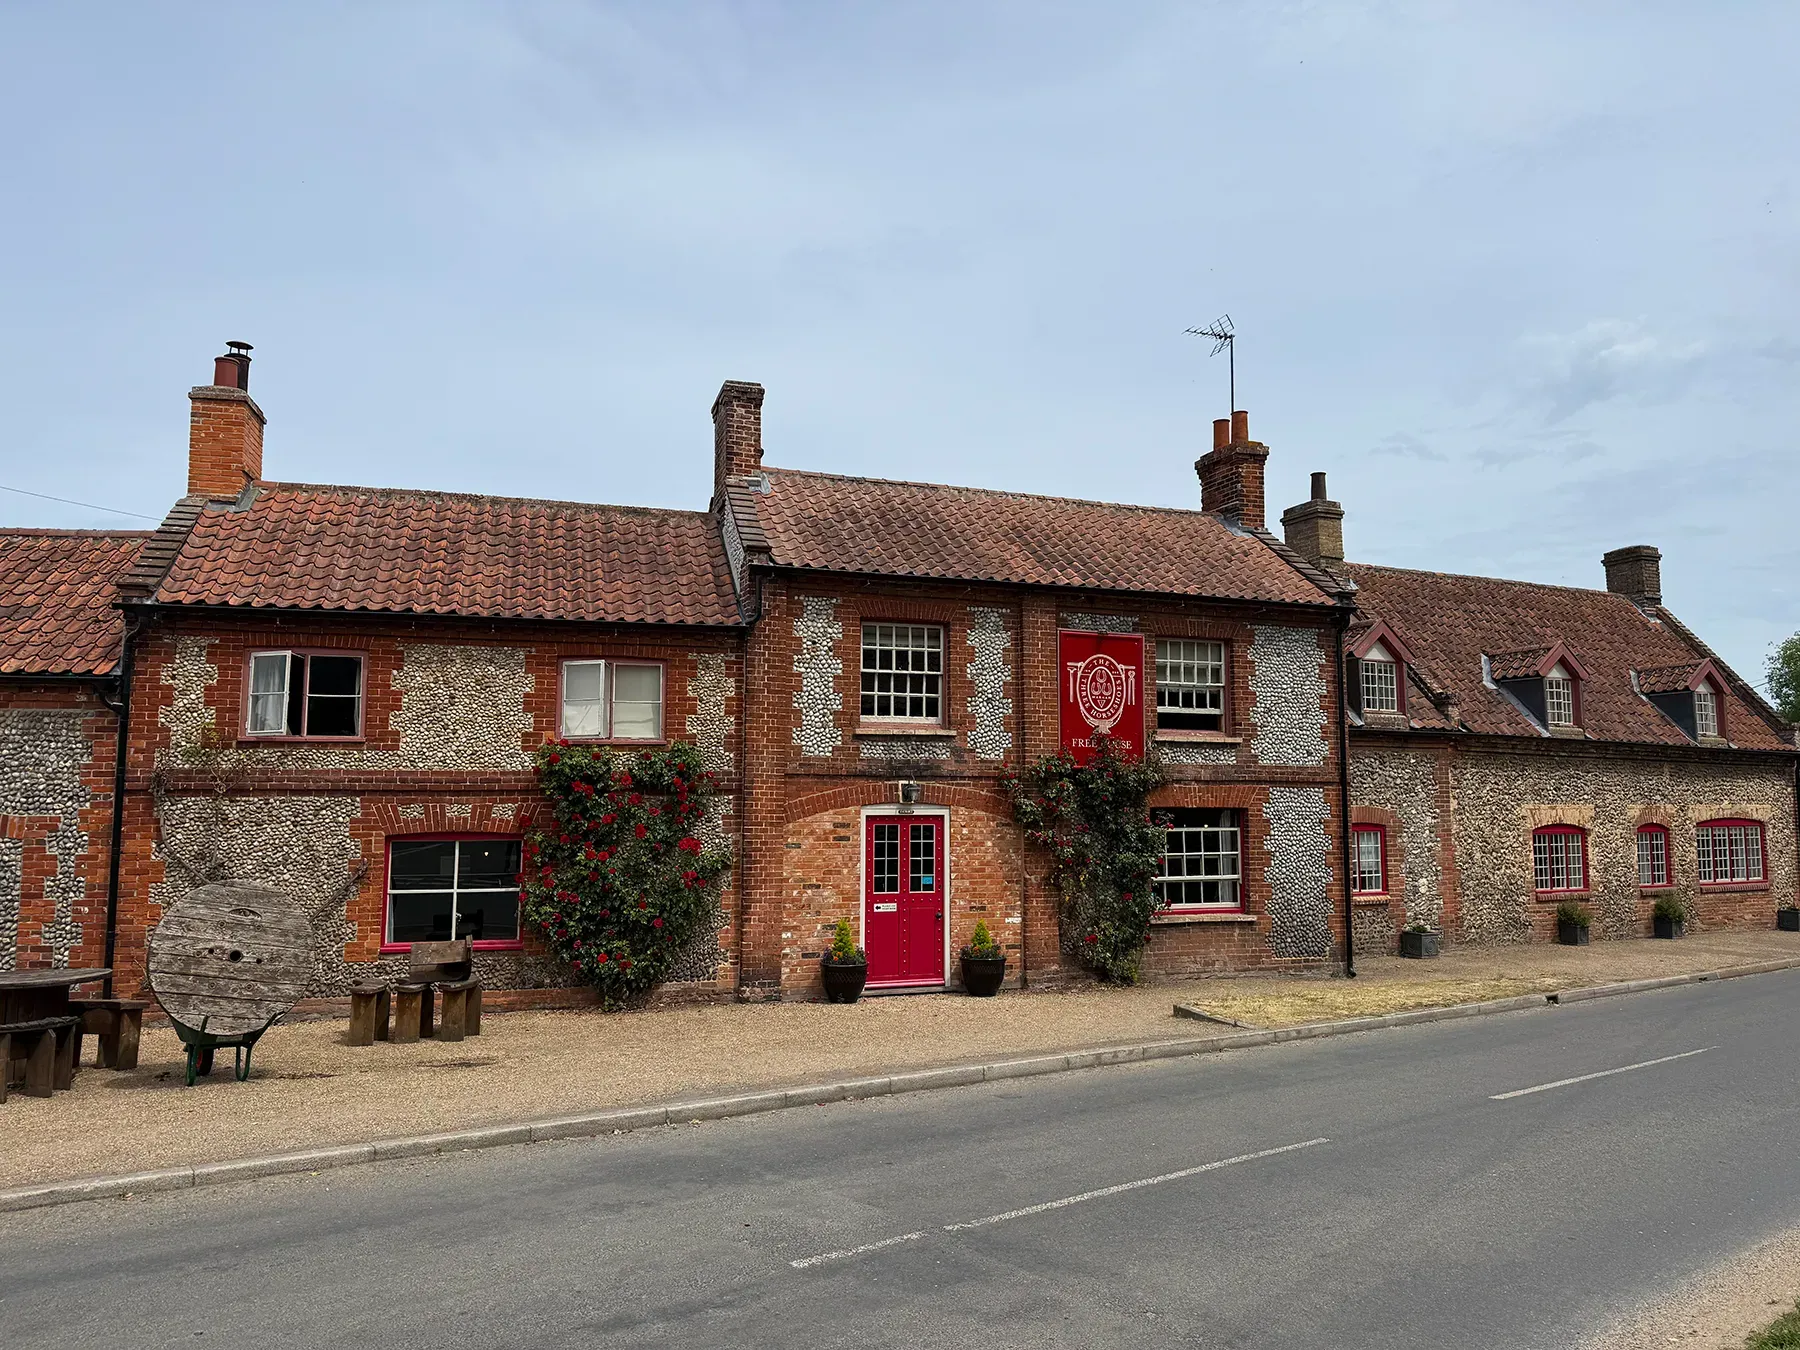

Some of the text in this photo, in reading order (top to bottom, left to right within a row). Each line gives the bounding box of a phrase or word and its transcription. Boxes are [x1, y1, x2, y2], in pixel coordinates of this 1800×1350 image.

[1080, 678, 1122, 718] THREE HORSESHOES
[1072, 738, 1098, 748] FREE
